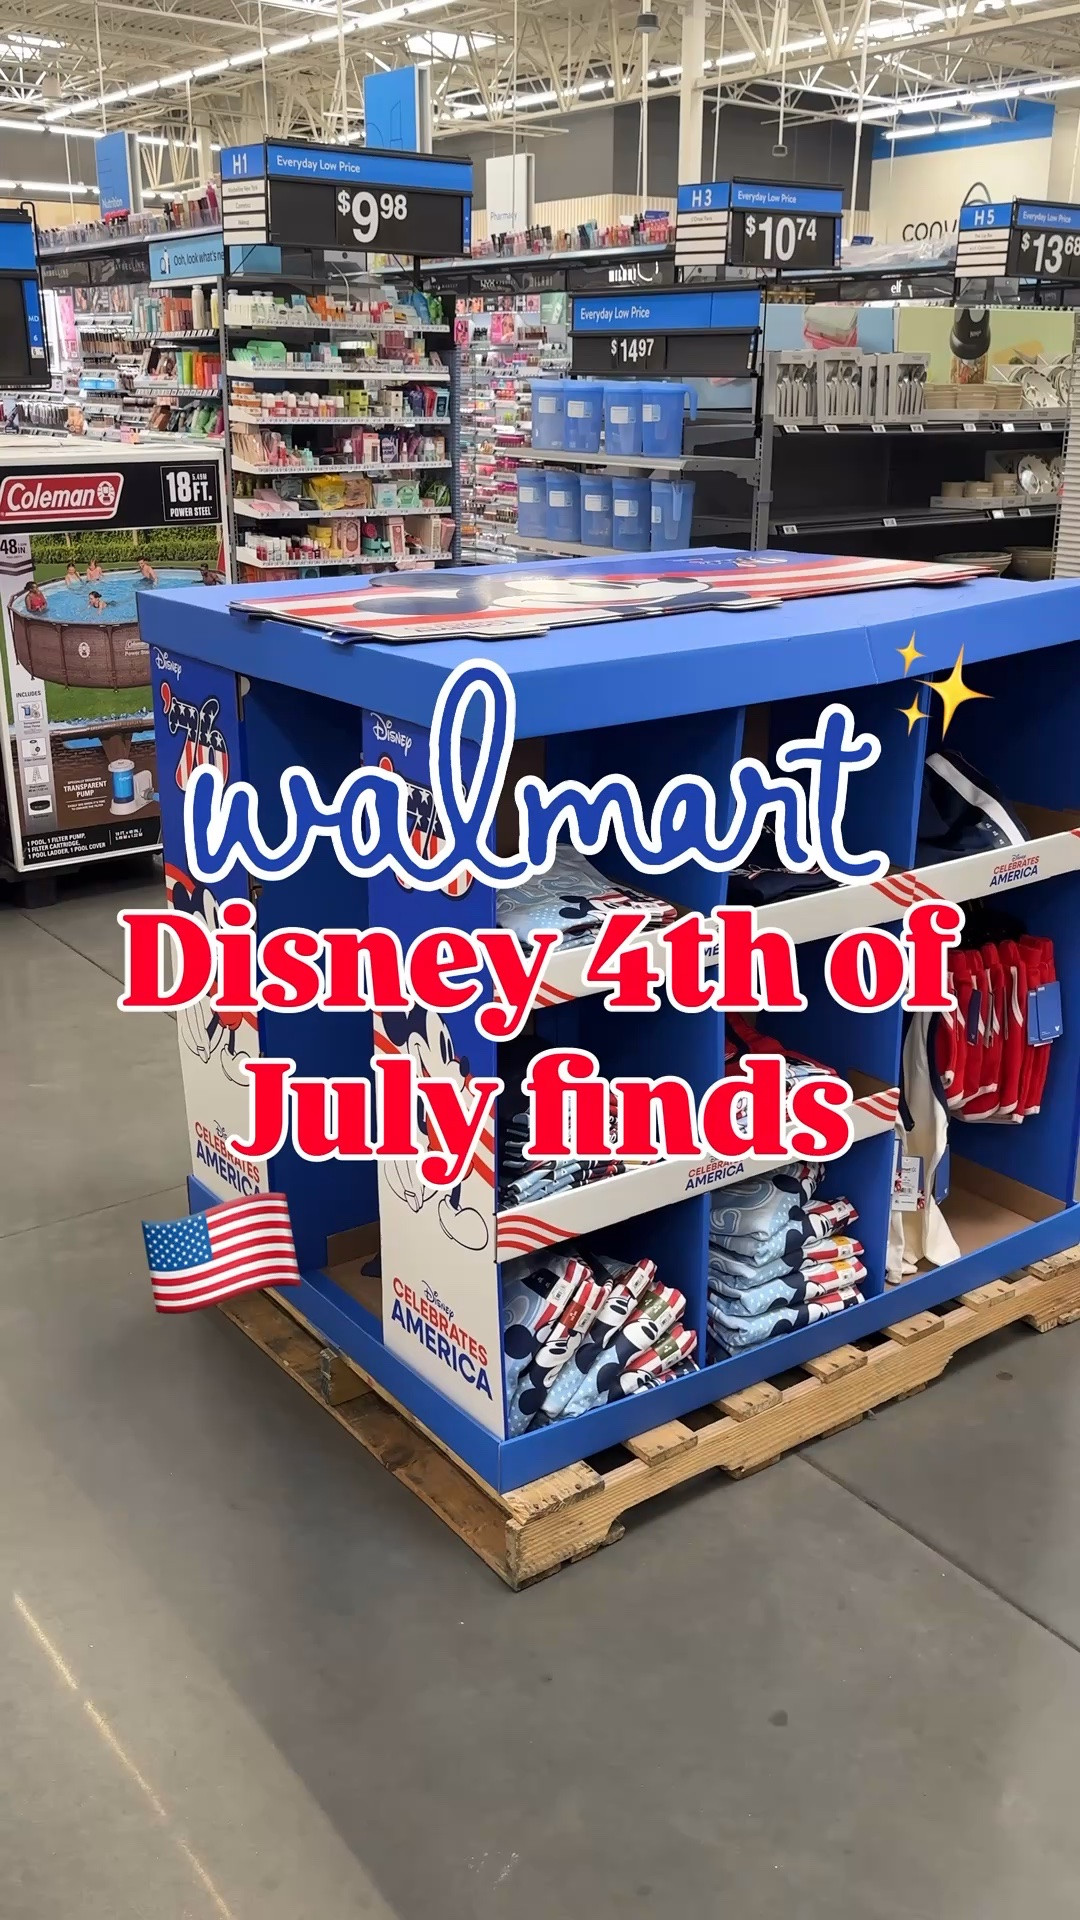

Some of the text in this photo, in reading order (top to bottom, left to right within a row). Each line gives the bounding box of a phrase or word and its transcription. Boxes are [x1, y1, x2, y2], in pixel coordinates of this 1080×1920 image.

[277, 155, 361, 173] Everyday Low Price
[738, 190, 797, 204] Everyday Low Price
[490, 210, 518, 222] Pharmacy
[1023, 211, 1072, 223] Everyday Low Price
[173, 252, 186, 267] Ooh,
[186, 251, 199, 264] look
[199, 249, 218, 263] what's
[580, 305, 650, 323] Everyday Low Price
[33, 334, 39, 342] 6
[166, 471, 213, 503] 18 FT.
[7, 482, 96, 513] Coleman
[170, 507, 193, 518] POWER
[0, 538, 26, 555] 48 IN
[16, 690, 42, 698] INCLUDES
[370, 712, 412, 757] Disney
[63, 781, 107, 792] TRANSPARENT
[76, 789, 95, 798] PUMP
[51, 835, 68, 843] FILTER
[31, 844, 48, 853] FILTER
[32, 851, 46, 859] POOL
[74, 844, 88, 852] POOL
[89, 842, 106, 850] COVER
[993, 855, 1040, 875] CELEBRATES
[989, 864, 1038, 887] AMERICA
[685, 1162, 745, 1191] AMERICA
[421, 1279, 455, 1321] Disney
[392, 1277, 488, 1366] CELEBRATES
[391, 1298, 493, 1401] AMERICA
